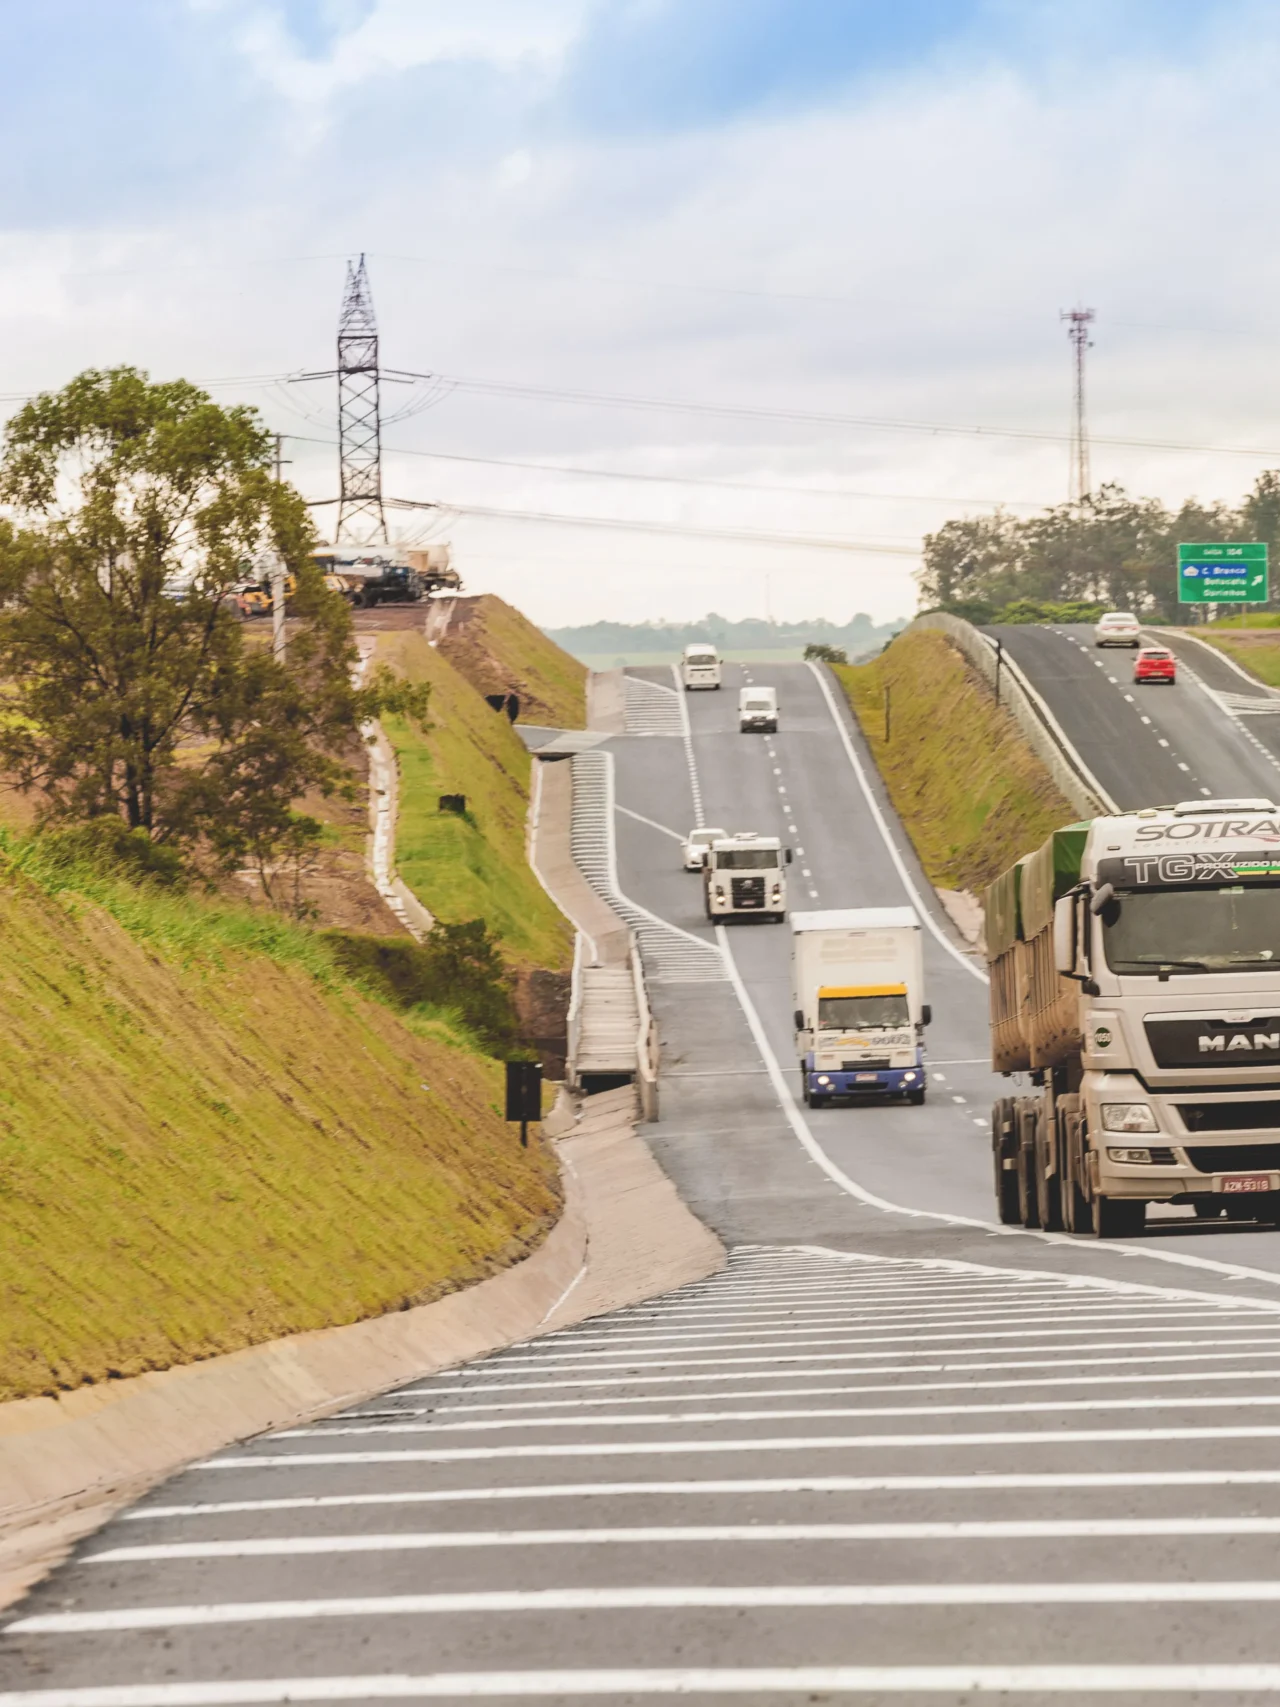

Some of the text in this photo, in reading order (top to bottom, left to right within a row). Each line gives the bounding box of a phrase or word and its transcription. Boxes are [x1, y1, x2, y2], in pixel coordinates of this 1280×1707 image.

[1124, 852, 1240, 884] TGX
[1195, 860, 1271, 870] PRODUZIDO
[1198, 1032, 1280, 1052] MAN
